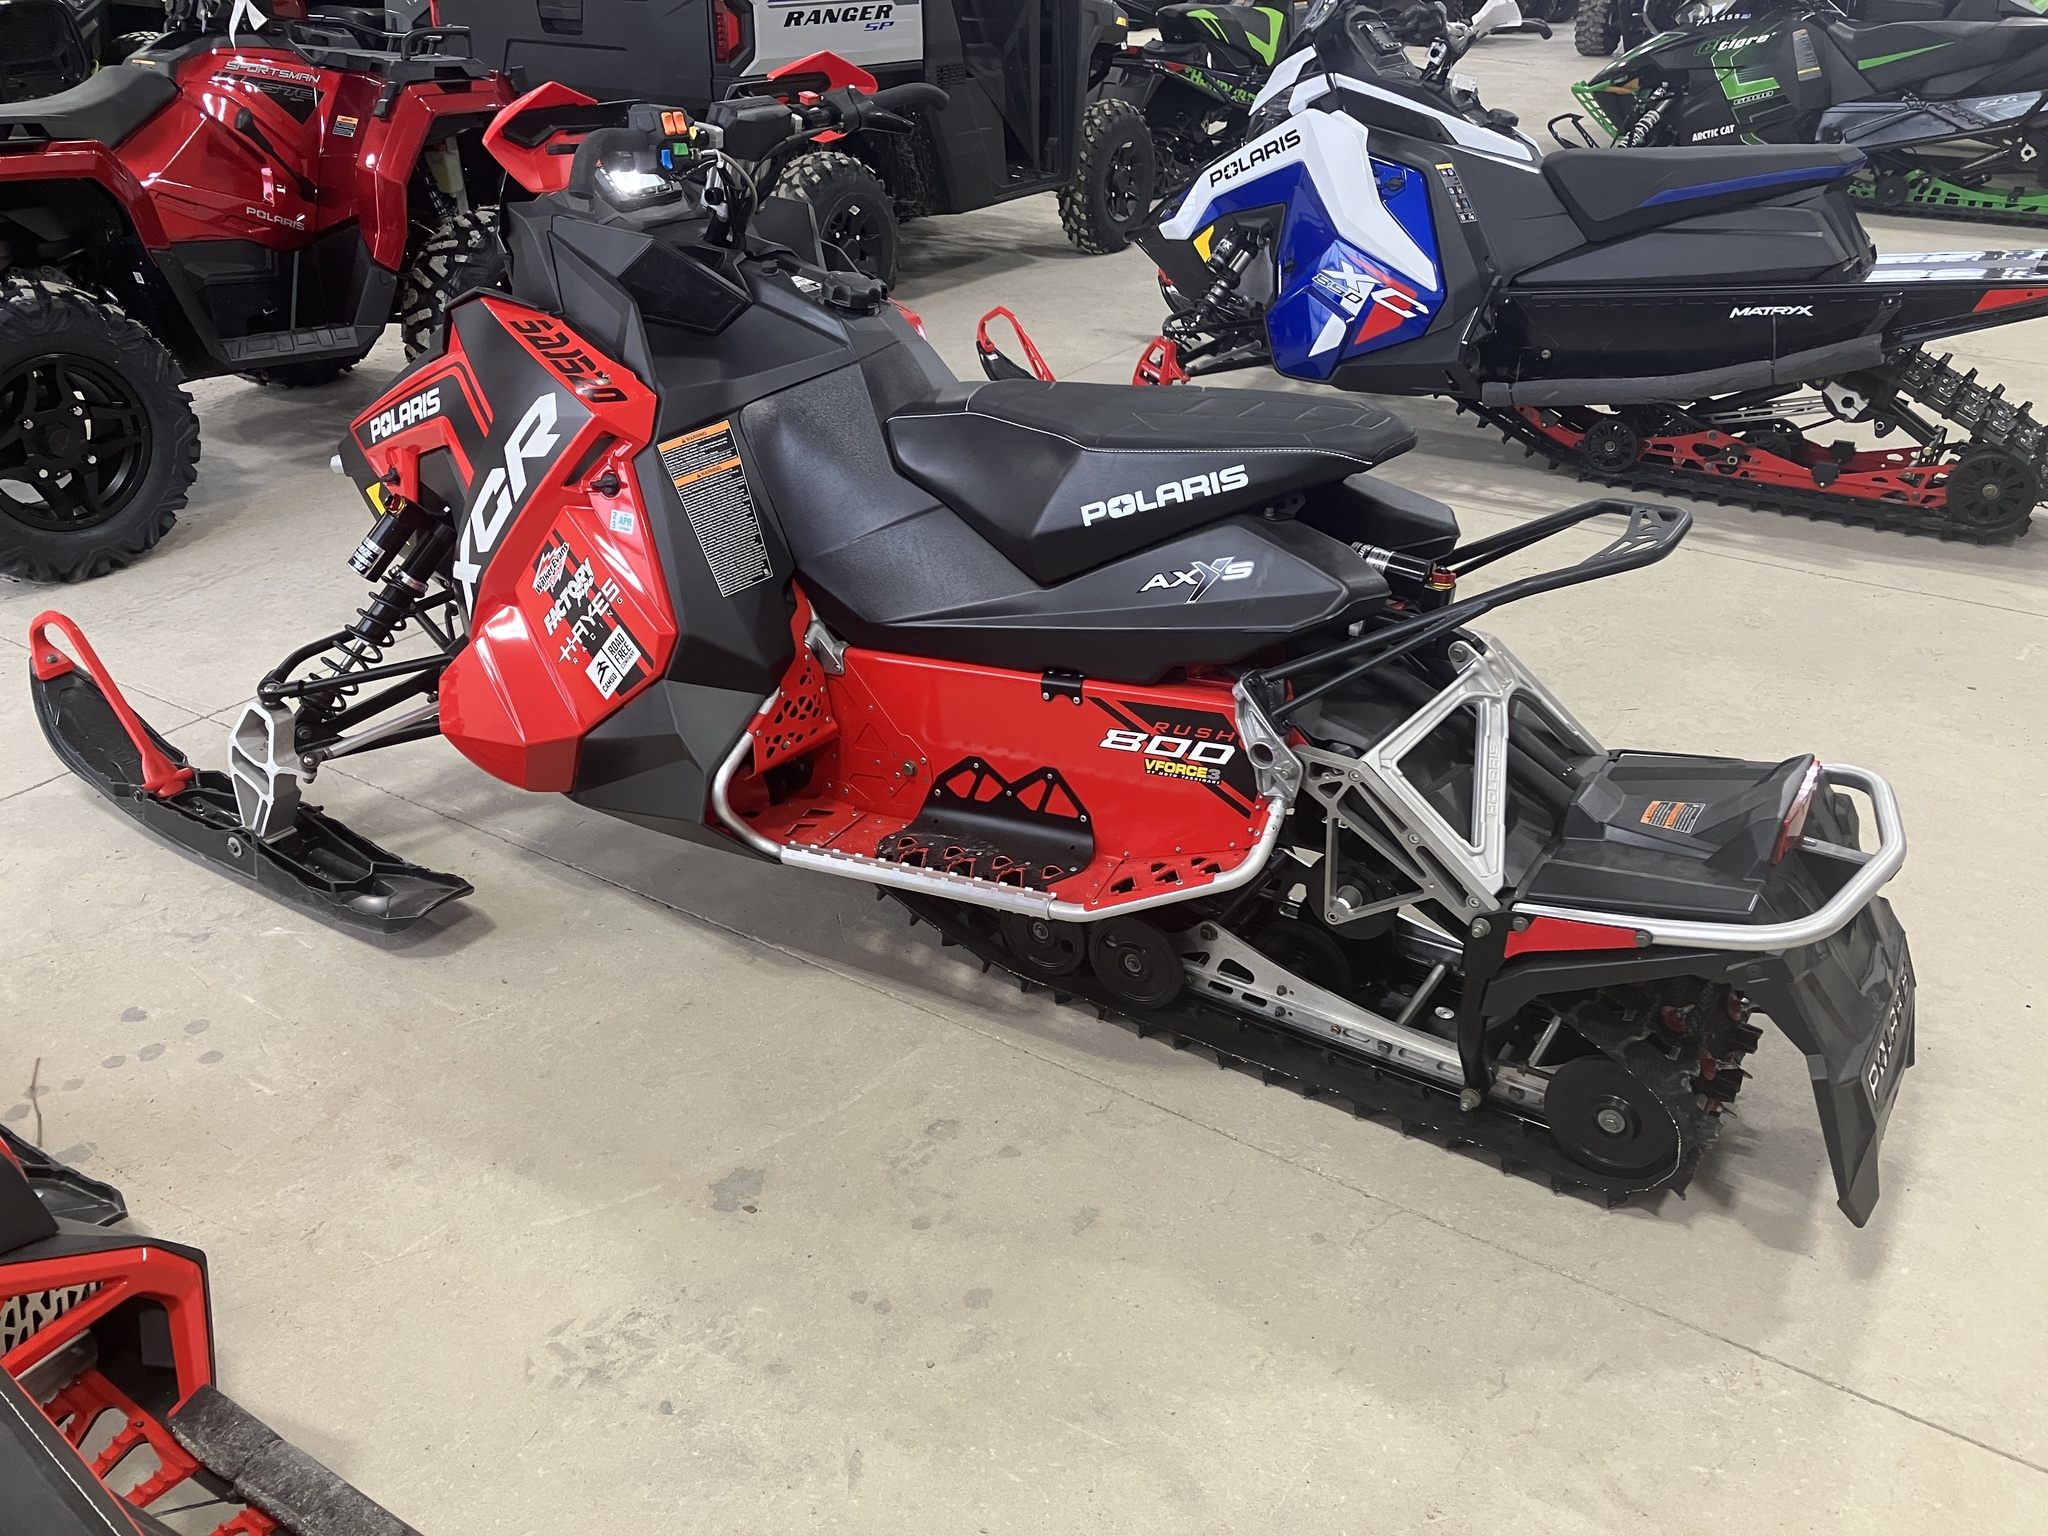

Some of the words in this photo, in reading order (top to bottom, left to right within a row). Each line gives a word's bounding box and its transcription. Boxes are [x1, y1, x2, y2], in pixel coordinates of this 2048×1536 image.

[784, 4, 893, 27] RANGER
[863, 21, 895, 31] SP
[225, 60, 320, 83] SPORTSMAN
[1692, 128, 1719, 142] ARCTIC
[1720, 124, 1736, 136] CAT
[1209, 129, 1301, 188] POLARIS
[246, 206, 305, 231] POLARIS
[1729, 305, 1814, 319] MATRYX
[370, 387, 441, 444] POLARIS
[453, 392, 561, 621] XCR
[1080, 464, 1249, 527] POLARIS
[619, 516, 632, 527] APR
[536, 568, 555, 593] Walker
[551, 543, 569, 569] Evans
[1136, 556, 1255, 604] AXYS
[544, 556, 591, 636] FACTORY
[607, 632, 626, 657] ROAD
[614, 640, 632, 665] FREE
[621, 650, 636, 670] COMPANY
[602, 672, 619, 693] CAMSO
[1153, 721, 1236, 742] RUSH
[1099, 728, 1236, 765] 800
[1144, 758, 1221, 780] VFORCE3
[1487, 743, 1500, 818] POLARIS
[1868, 962, 1909, 1101] POLARIS
